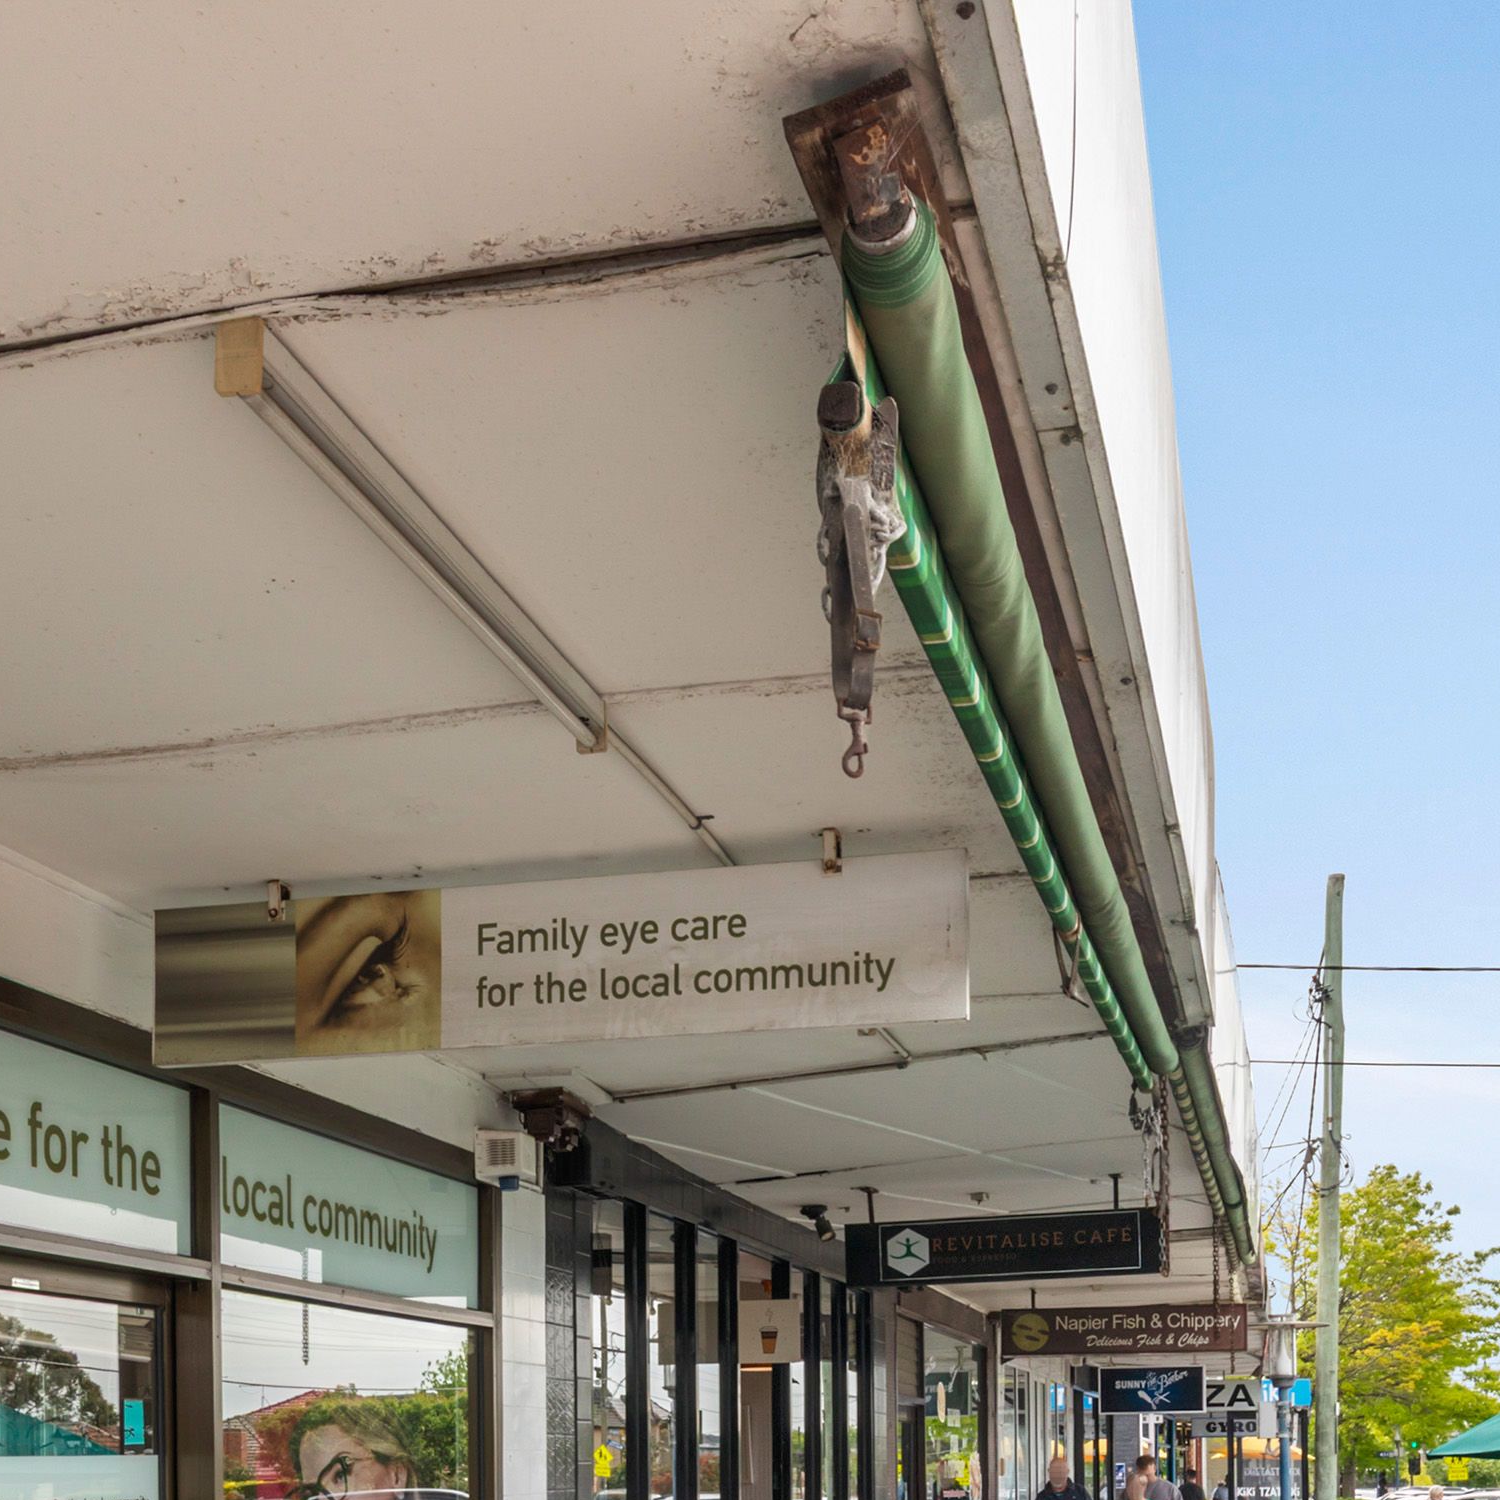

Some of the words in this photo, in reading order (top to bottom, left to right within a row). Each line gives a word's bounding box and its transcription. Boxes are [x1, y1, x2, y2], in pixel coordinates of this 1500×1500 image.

[476, 917, 588, 957] Family
[600, 921, 659, 953] eye
[670, 911, 747, 944] care
[476, 973, 524, 1007] for
[533, 970, 586, 1003] the
[601, 963, 681, 1000] local
[692, 951, 896, 994] community
[28, 1101, 89, 1178] for
[101, 1124, 161, 1196] the
[221, 1154, 295, 1230] local
[303, 1193, 438, 1273] community
[932, 1231, 1064, 1252] REVITALISE
[1074, 1226, 1133, 1245] CAFÉ
[1055, 1316, 1108, 1333] Napier
[1112, 1314, 1146, 1330] Fish
[1150, 1313, 1163, 1328] &
[1167, 1312, 1241, 1331] Chippery
[1086, 1334, 1133, 1347] Delicious
[1136, 1334, 1162, 1347] Fish
[1166, 1333, 1174, 1345] &
[1177, 1332, 1210, 1347] Chips
[1115, 1379, 1147, 1390] SUNNY
[1206, 1383, 1255, 1407] ZA
